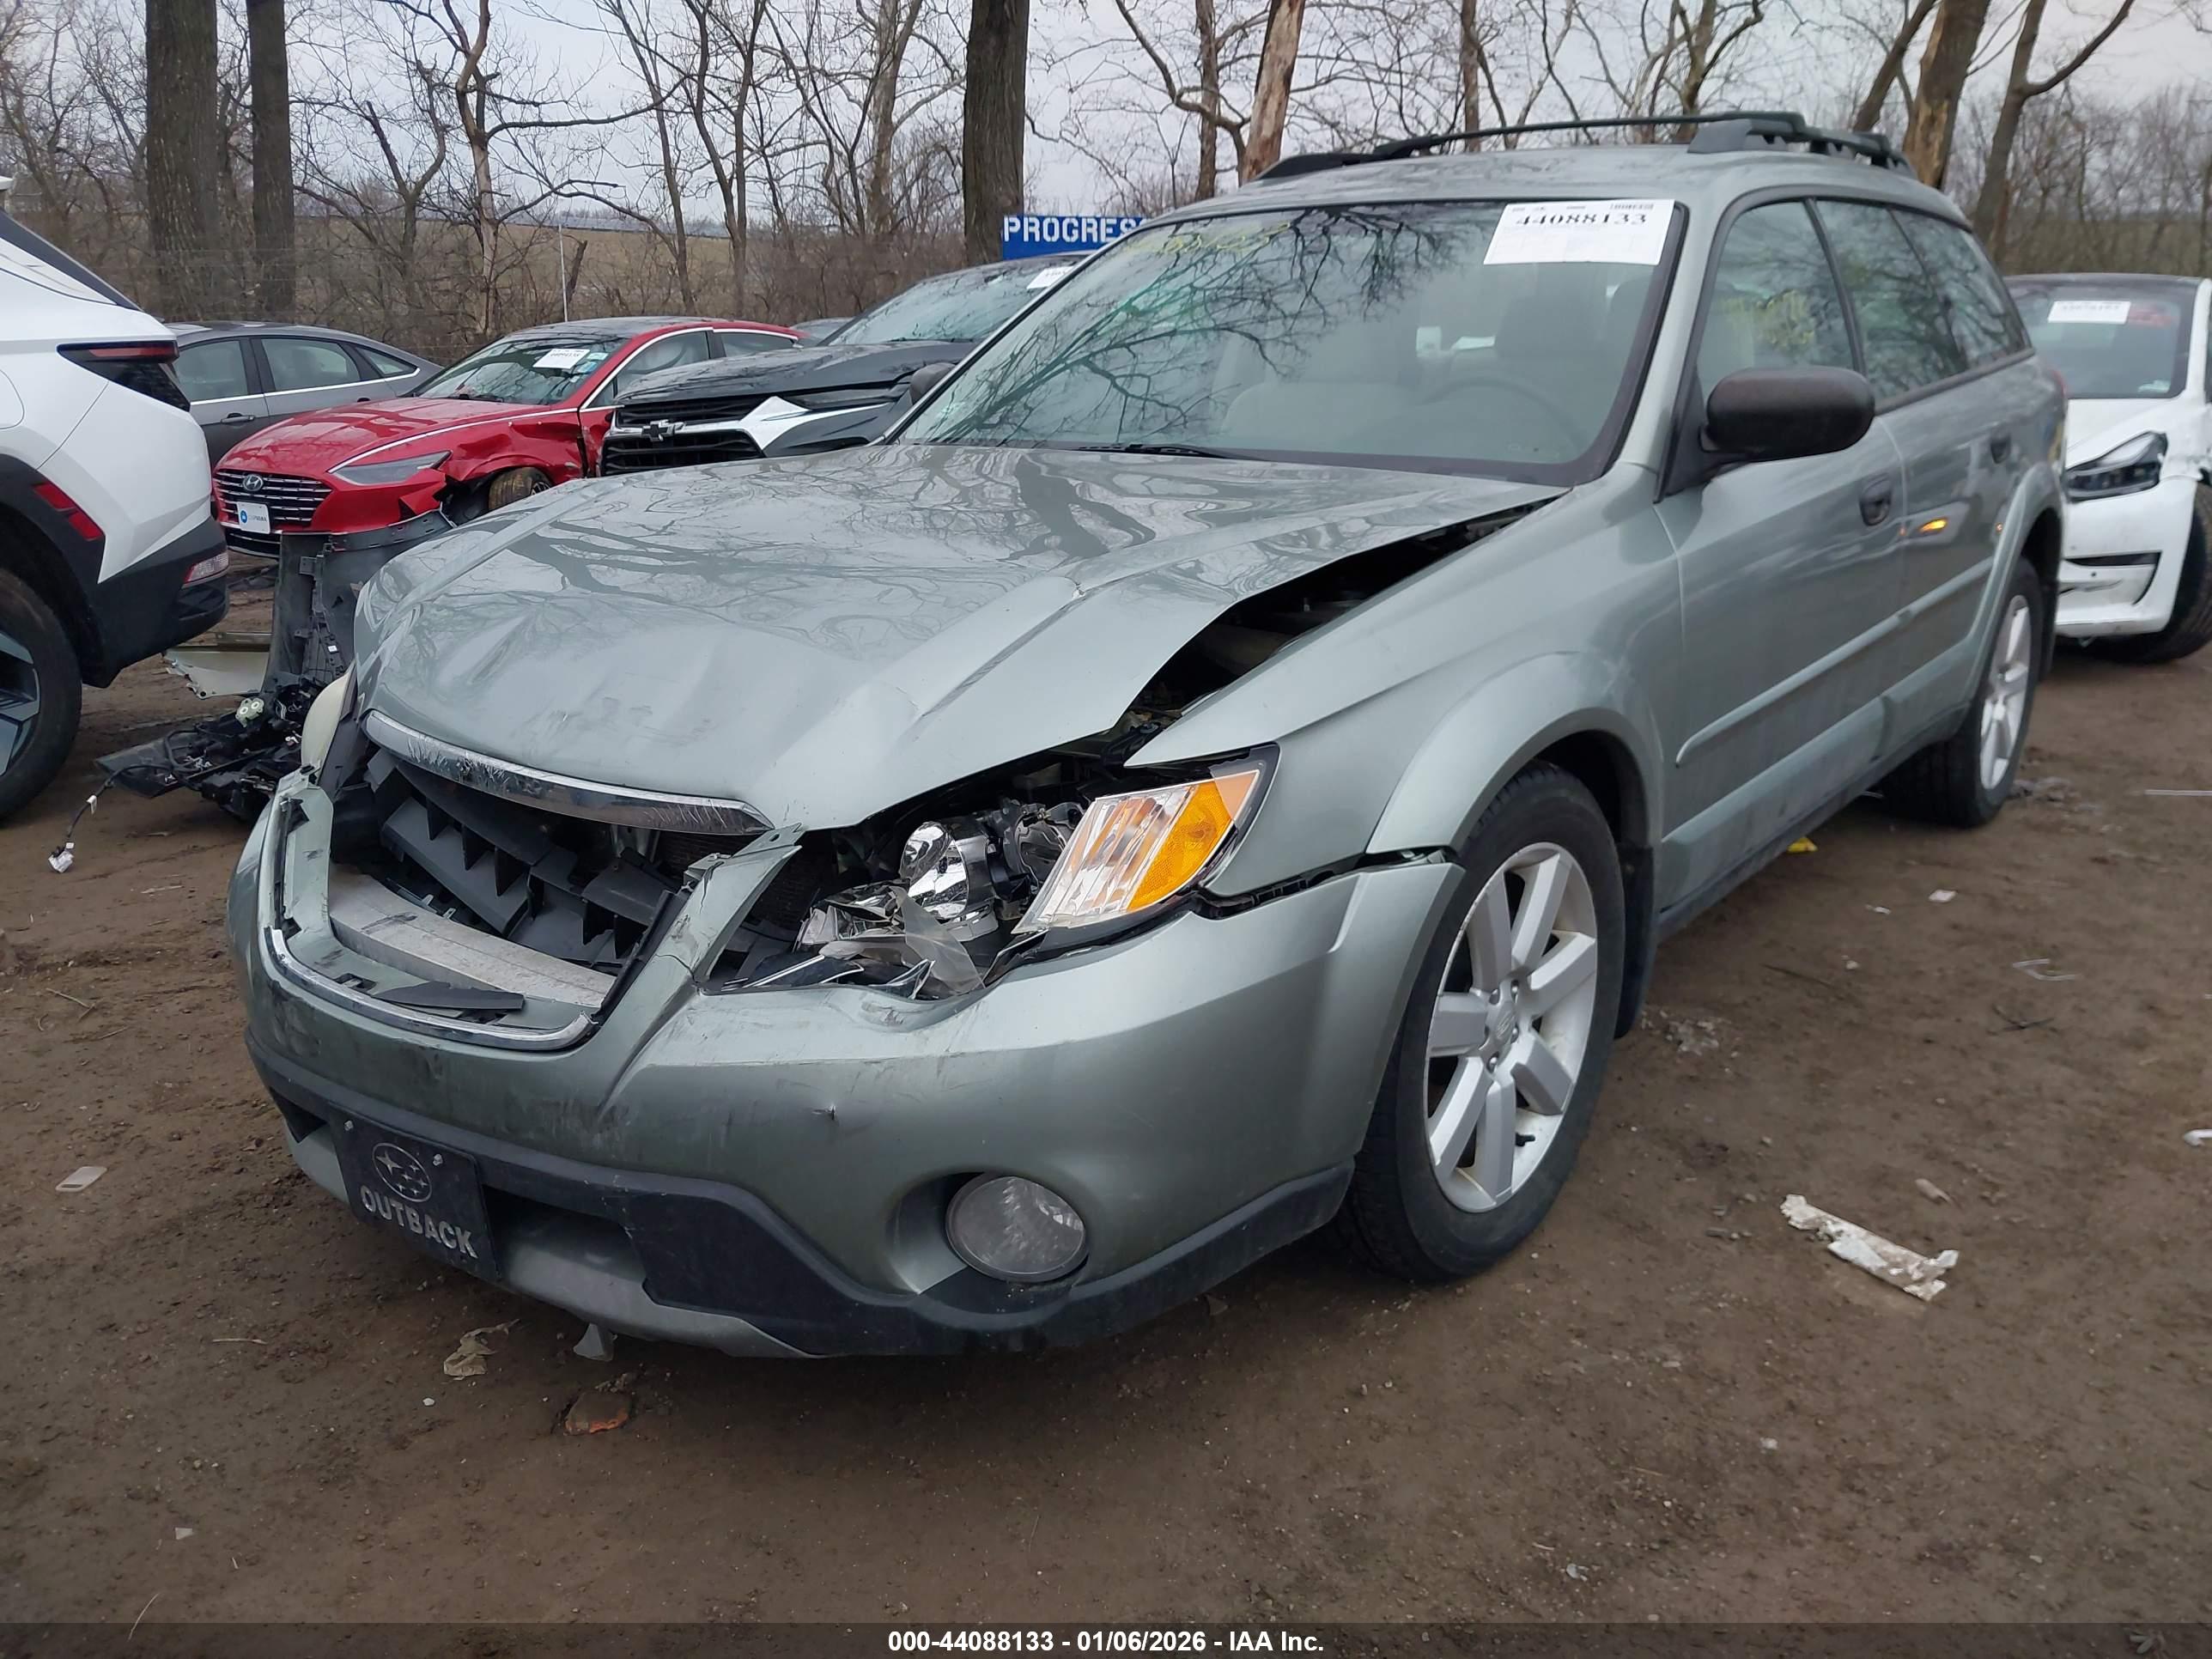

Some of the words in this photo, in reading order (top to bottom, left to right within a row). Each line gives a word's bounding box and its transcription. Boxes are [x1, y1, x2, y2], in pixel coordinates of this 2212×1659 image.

[1003, 216, 1148, 243] PROGRES
[1516, 214, 1647, 225] 44088133
[360, 1185, 478, 1259] OUTBACK
